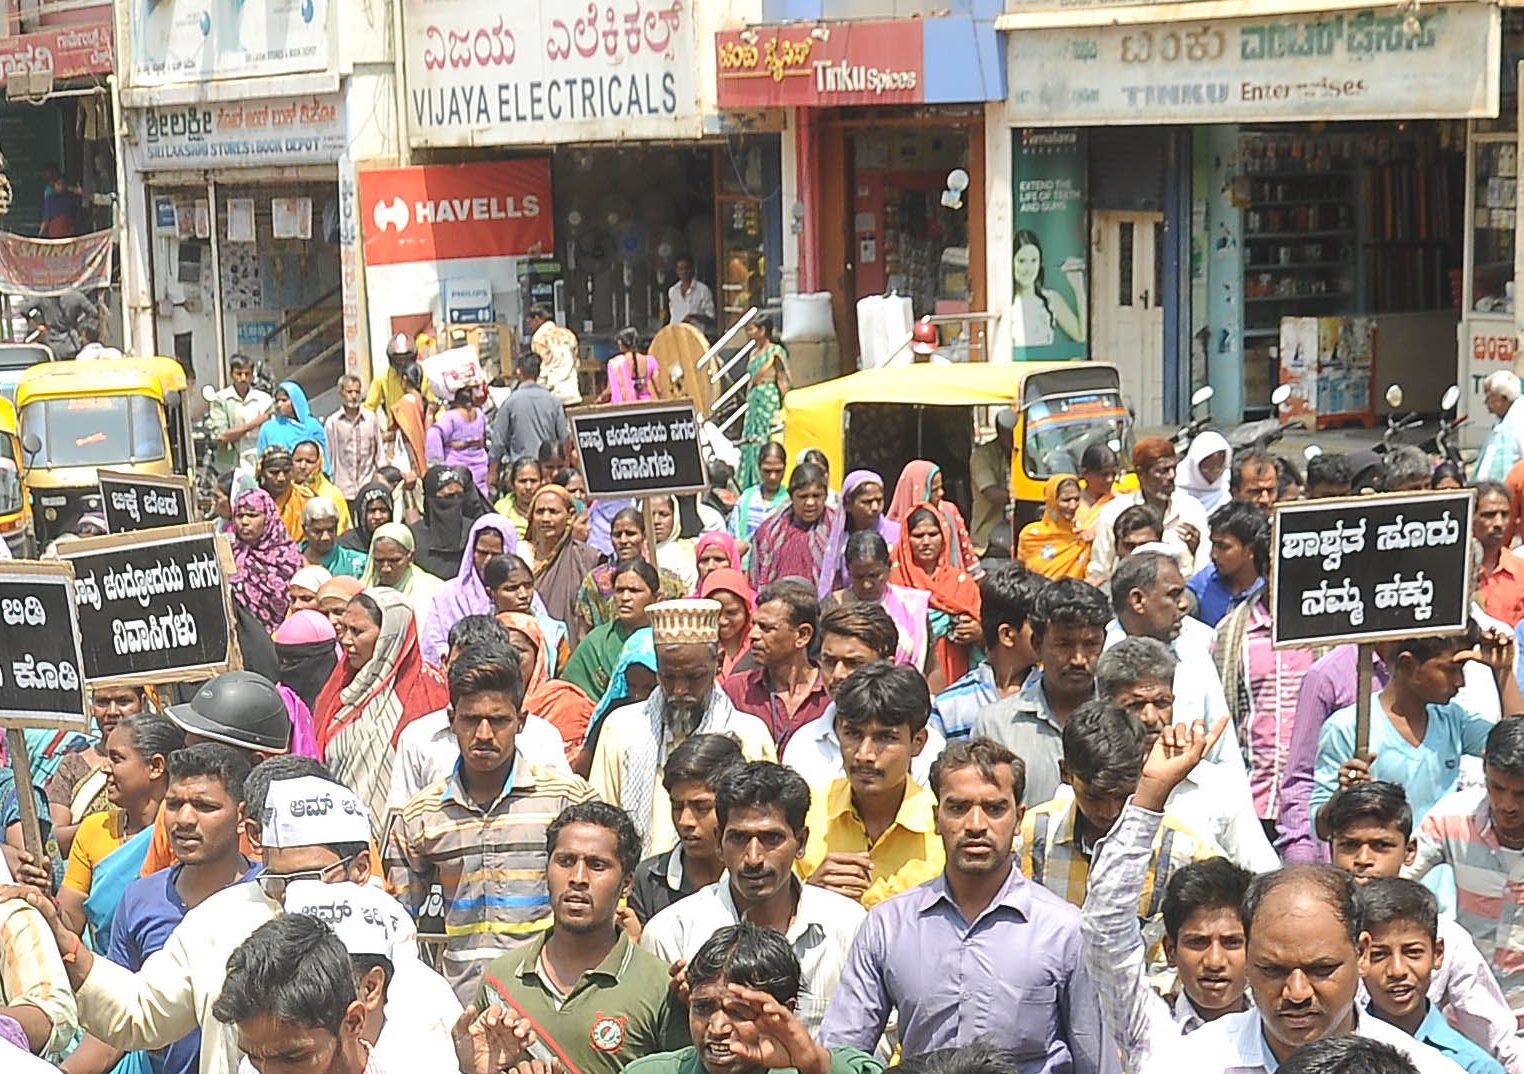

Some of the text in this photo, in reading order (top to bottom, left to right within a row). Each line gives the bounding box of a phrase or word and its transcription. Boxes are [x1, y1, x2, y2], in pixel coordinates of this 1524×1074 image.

[424, 15, 516, 71] ವಿಜಯ
[812, 59, 917, 95] Tinku Spices
[413, 69, 678, 127] VIJAYA ELECTRICALS
[211, 138, 250, 156] STORES
[285, 135, 320, 152] DEPOT
[415, 195, 540, 224] HAVELLS
[578, 417, 696, 453] ನಾವು ಚಂದ್ರೋದಯ ನಗರ
[610, 448, 676, 481] ನಿವಾಸಿಗಳು
[1282, 511, 1458, 570] ಶಾಶ್ವತ ಸೂರು
[104, 558, 185, 608] ಚಂದ್ರೋದಯ
[187, 550, 220, 588] ನಗರ
[1302, 571, 1433, 625] ನಮ್ಮ ಹಕ್ಕು
[2, 596, 45, 625] ಬಿಡಿ
[113, 600, 197, 654] ನಿವಾಸಿಗಳು
[13, 650, 80, 690] ಕೊಡಿ
[290, 793, 333, 817] ಆಮ್
